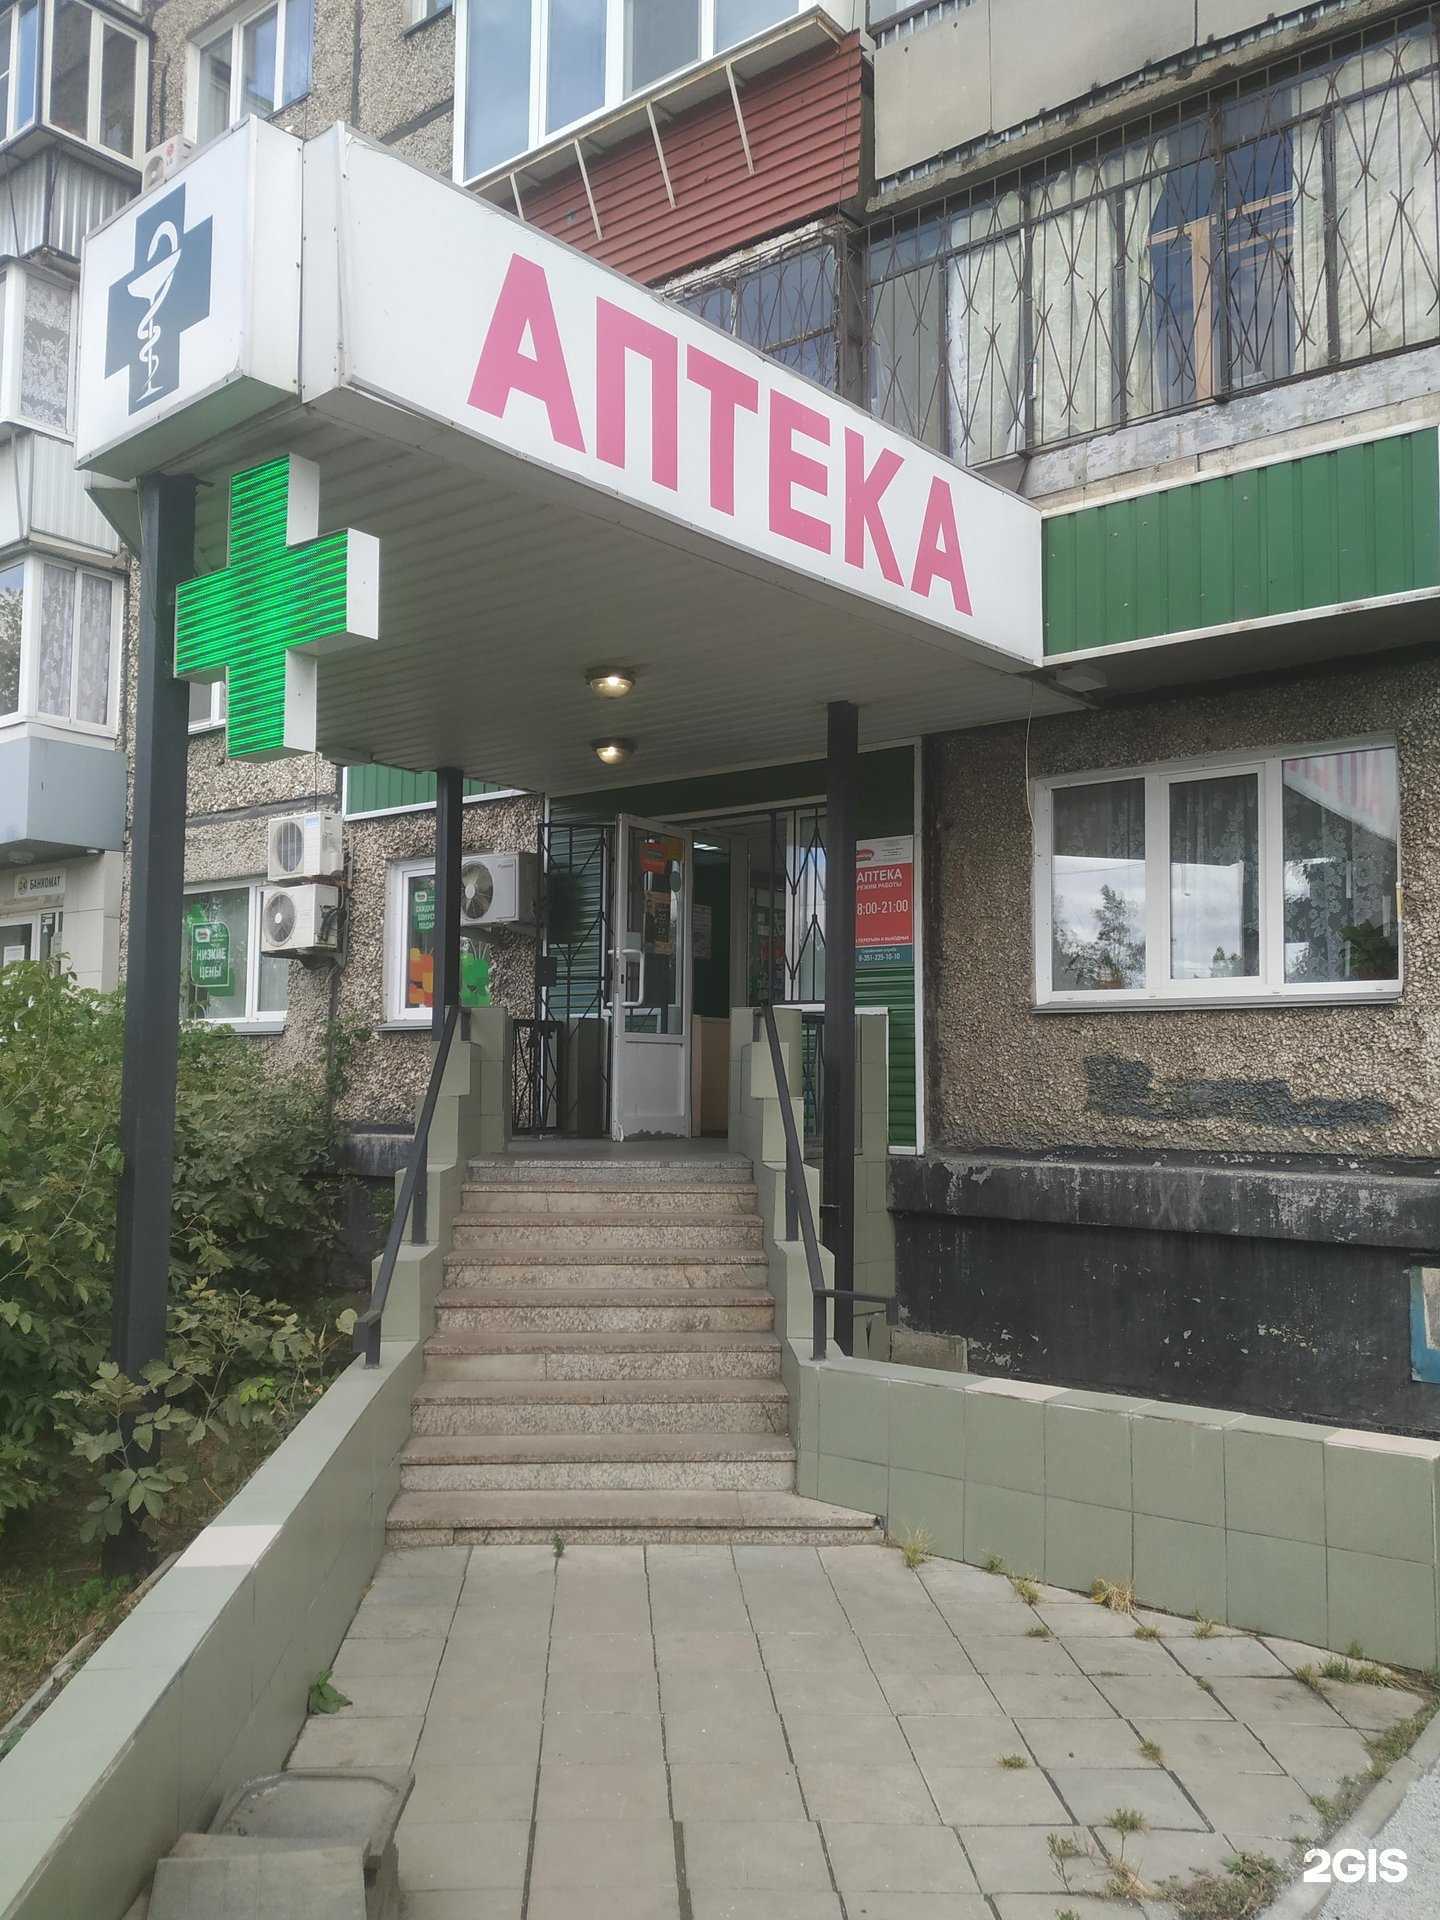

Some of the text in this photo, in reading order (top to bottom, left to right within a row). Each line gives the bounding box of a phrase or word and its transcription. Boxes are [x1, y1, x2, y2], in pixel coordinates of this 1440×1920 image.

[467, 253, 973, 617] АПТЕКА
[30, 875, 61, 891] БАНКОМАТ
[857, 868, 902, 883] АПТЕКА
[196, 948, 227, 961] НИЗКИЕ
[199, 965, 222, 979] ЦЕНЫ
